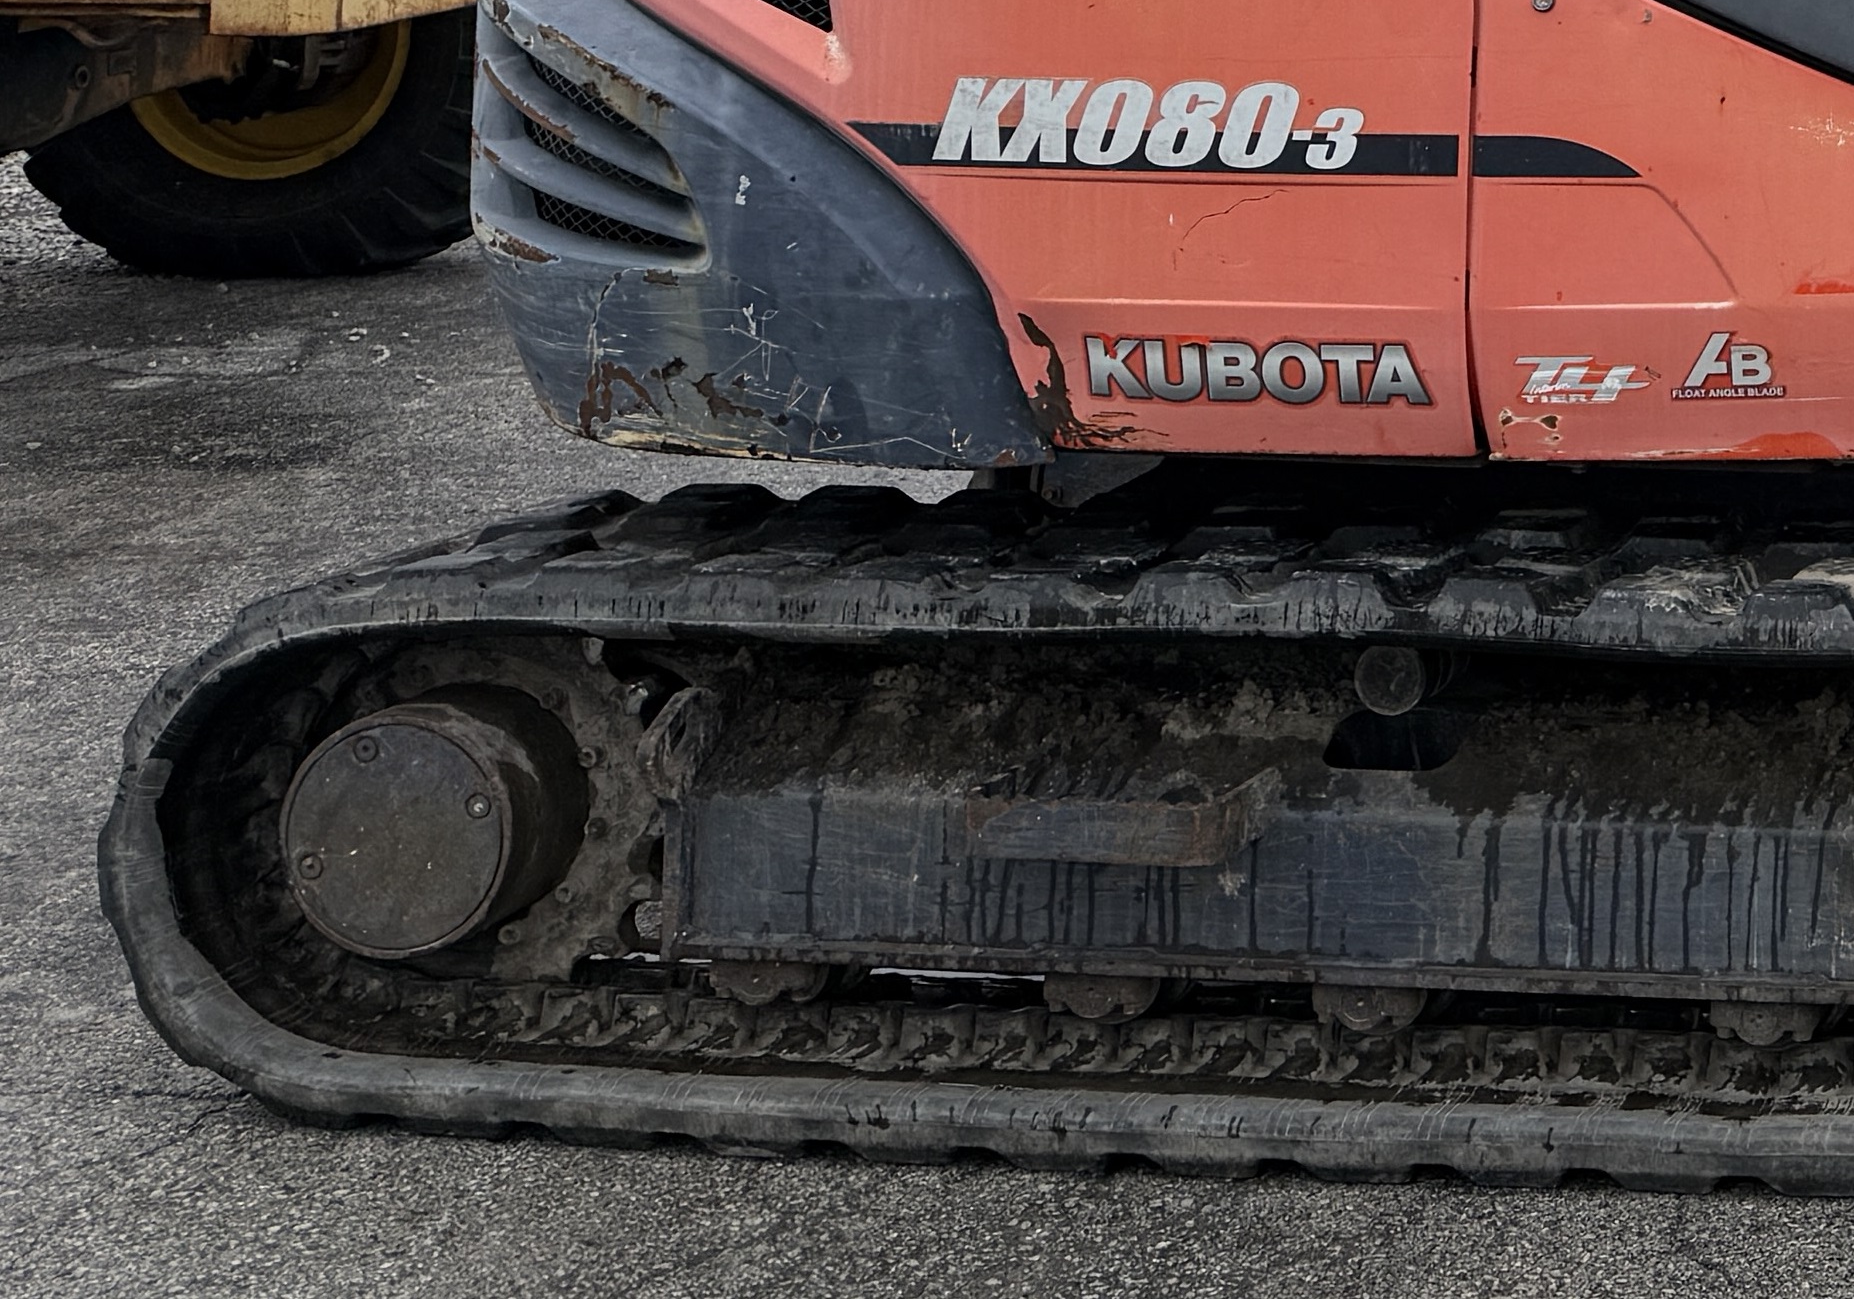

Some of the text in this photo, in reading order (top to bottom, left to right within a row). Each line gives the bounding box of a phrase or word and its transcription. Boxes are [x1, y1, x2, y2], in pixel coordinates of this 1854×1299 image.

[931, 77, 1365, 171] KX080-3
[1084, 334, 1434, 406] KUBOTA
[1672, 388, 1706, 398] FLOAT
[1708, 387, 1745, 398] ANGLE
